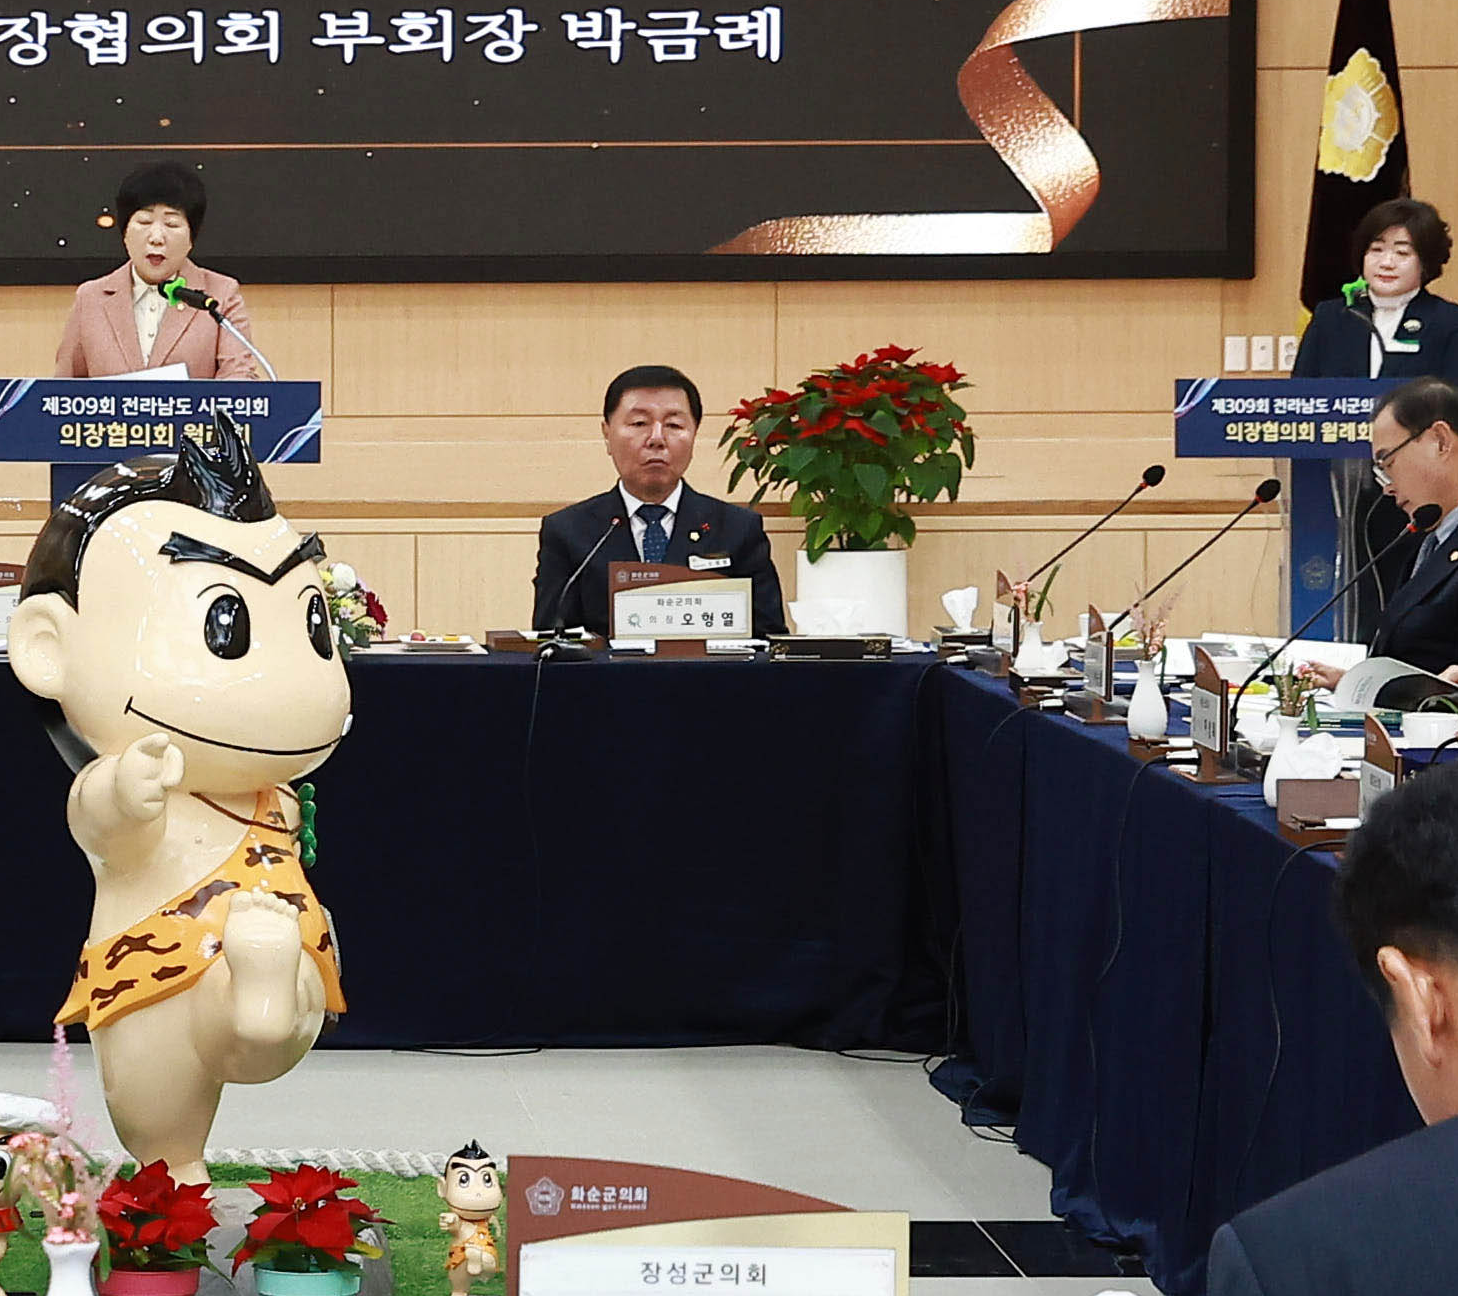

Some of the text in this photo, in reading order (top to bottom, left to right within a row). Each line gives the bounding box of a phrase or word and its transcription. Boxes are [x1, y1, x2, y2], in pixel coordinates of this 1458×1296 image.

[310, 6, 538, 68] 부회장
[560, 4, 785, 66] 박금례
[42, 396, 269, 417] 제309회 전라남도 시군의회
[1212, 398, 1269, 415] 제309회
[1273, 398, 1329, 415] 전라남도
[59, 422, 174, 447] 의장협의회
[1225, 421, 1373, 444] 의장협의회 월례회
[570, 1185, 648, 1202] 화순군의회
[640, 1262, 768, 1286] 장성군의회
